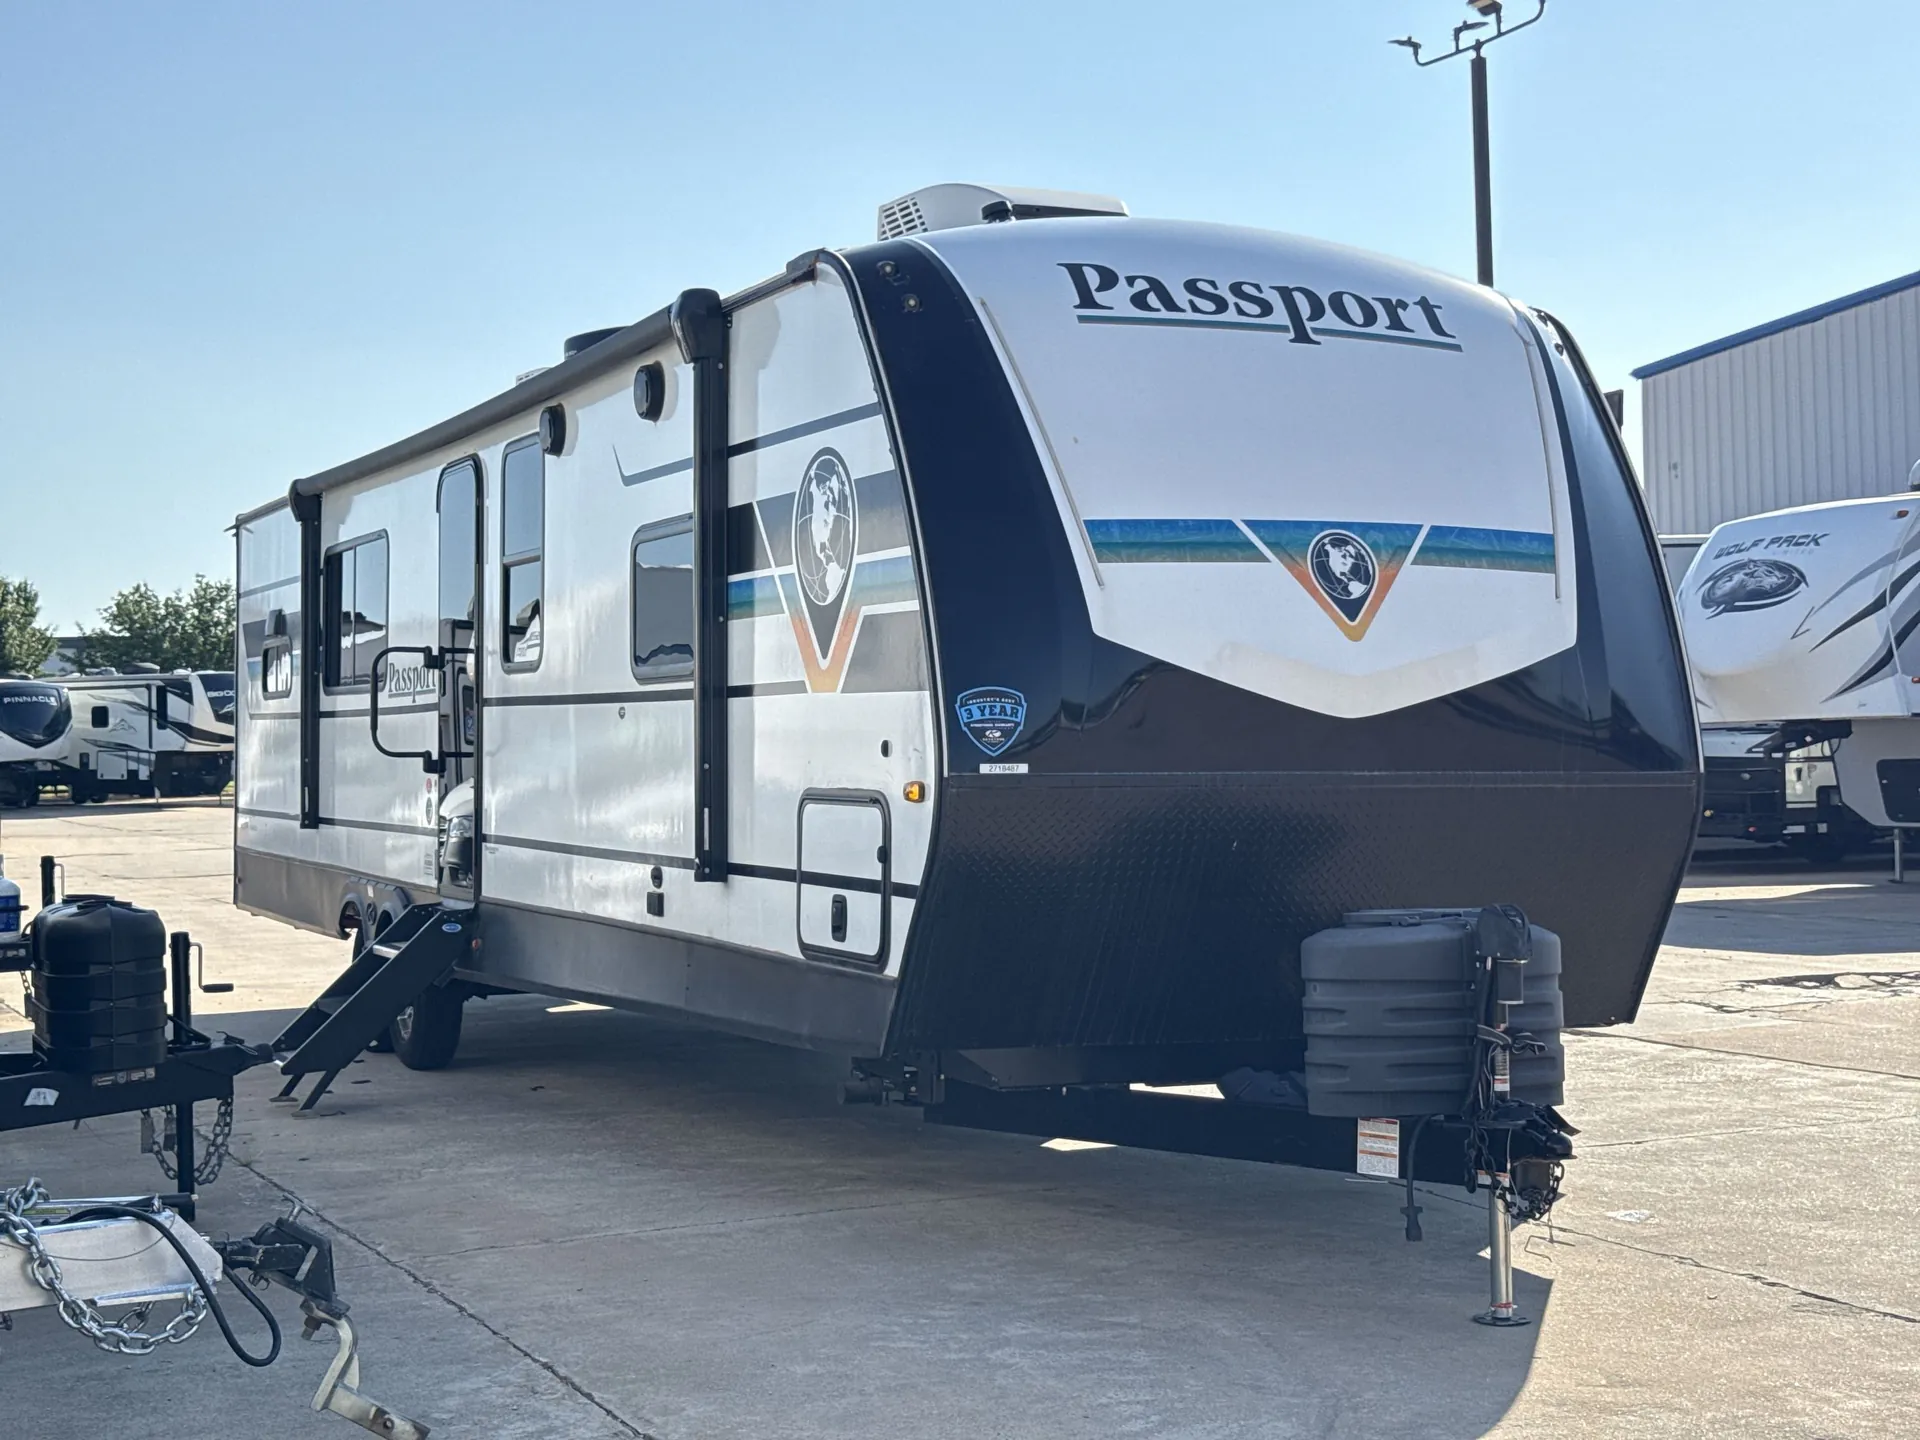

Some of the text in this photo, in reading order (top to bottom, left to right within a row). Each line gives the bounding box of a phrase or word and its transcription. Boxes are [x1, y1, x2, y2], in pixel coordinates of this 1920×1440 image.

[1057, 262, 1457, 345] Passport
[1712, 533, 1830, 560] WOLF PACK
[388, 662, 437, 704] Passport
[3, 695, 58, 705] PINNACLE
[963, 704, 1020, 720] 3 YEAR
